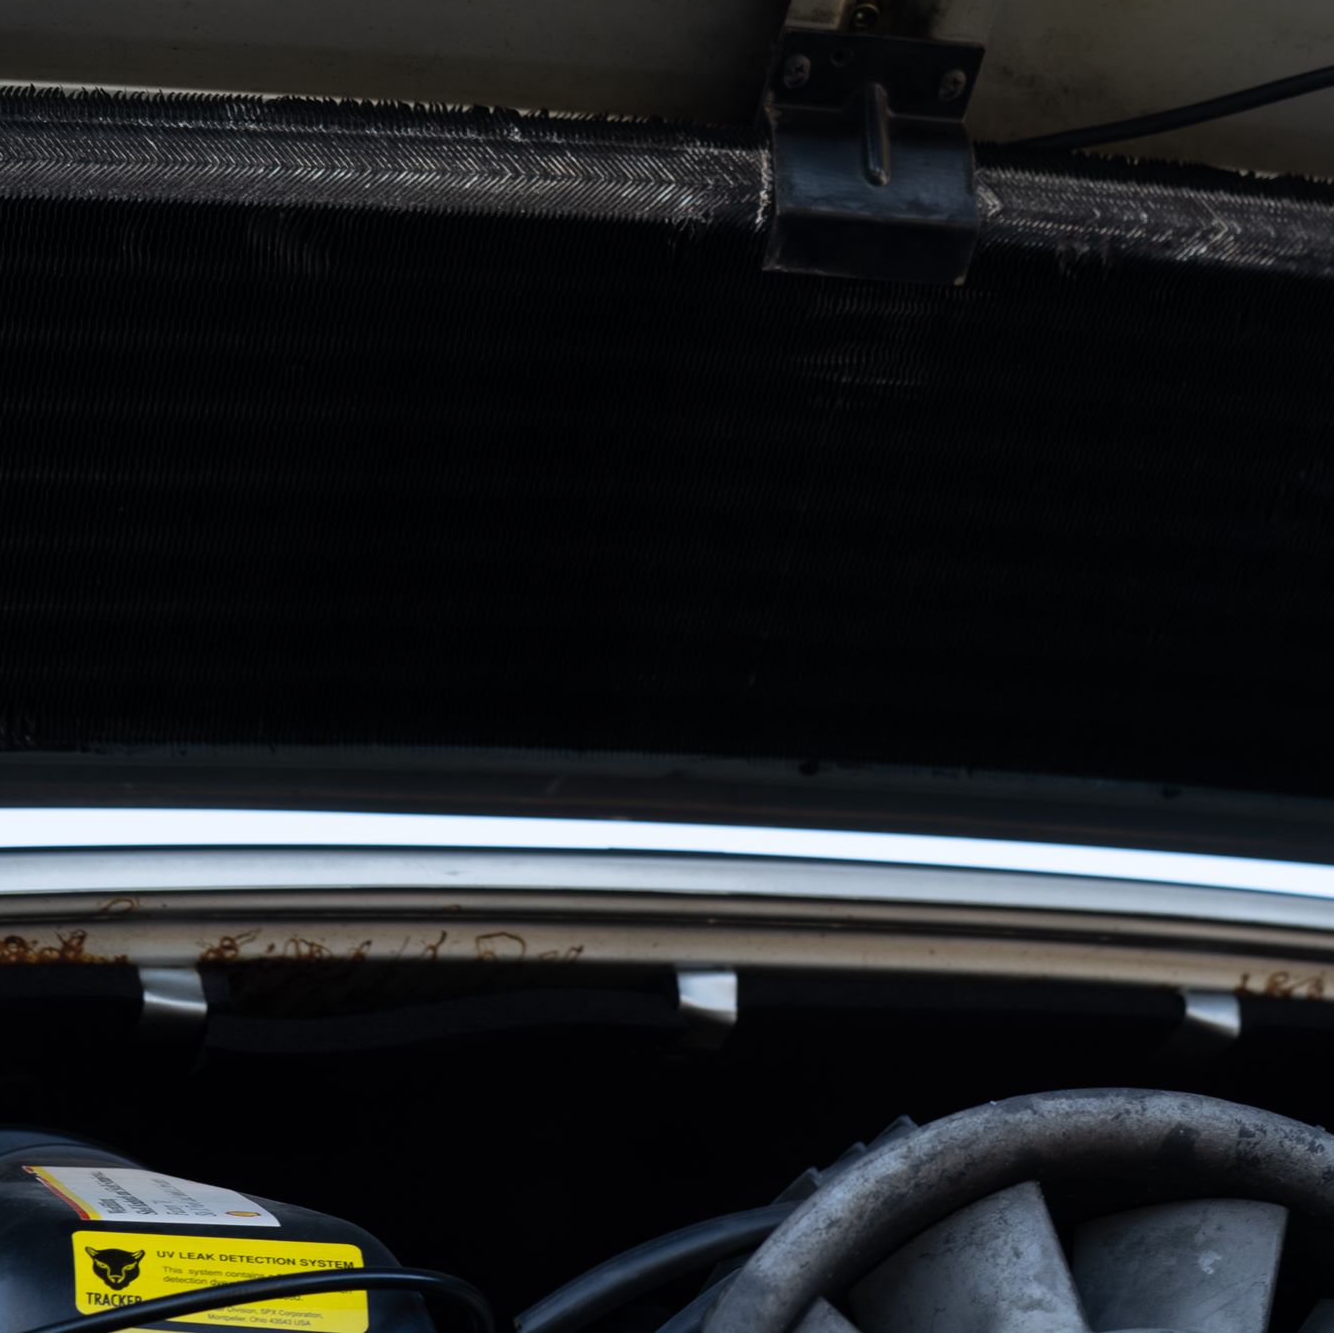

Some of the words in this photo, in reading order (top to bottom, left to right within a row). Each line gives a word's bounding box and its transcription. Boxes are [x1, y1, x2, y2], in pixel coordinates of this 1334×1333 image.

[157, 1250, 175, 1258] UV
[179, 1252, 215, 1261] LEAK
[219, 1254, 296, 1266] DETECTION
[300, 1259, 354, 1269] SYSTEM
[163, 1266, 183, 1274] This
[188, 1268, 223, 1278] system
[163, 1276, 207, 1285] detection
